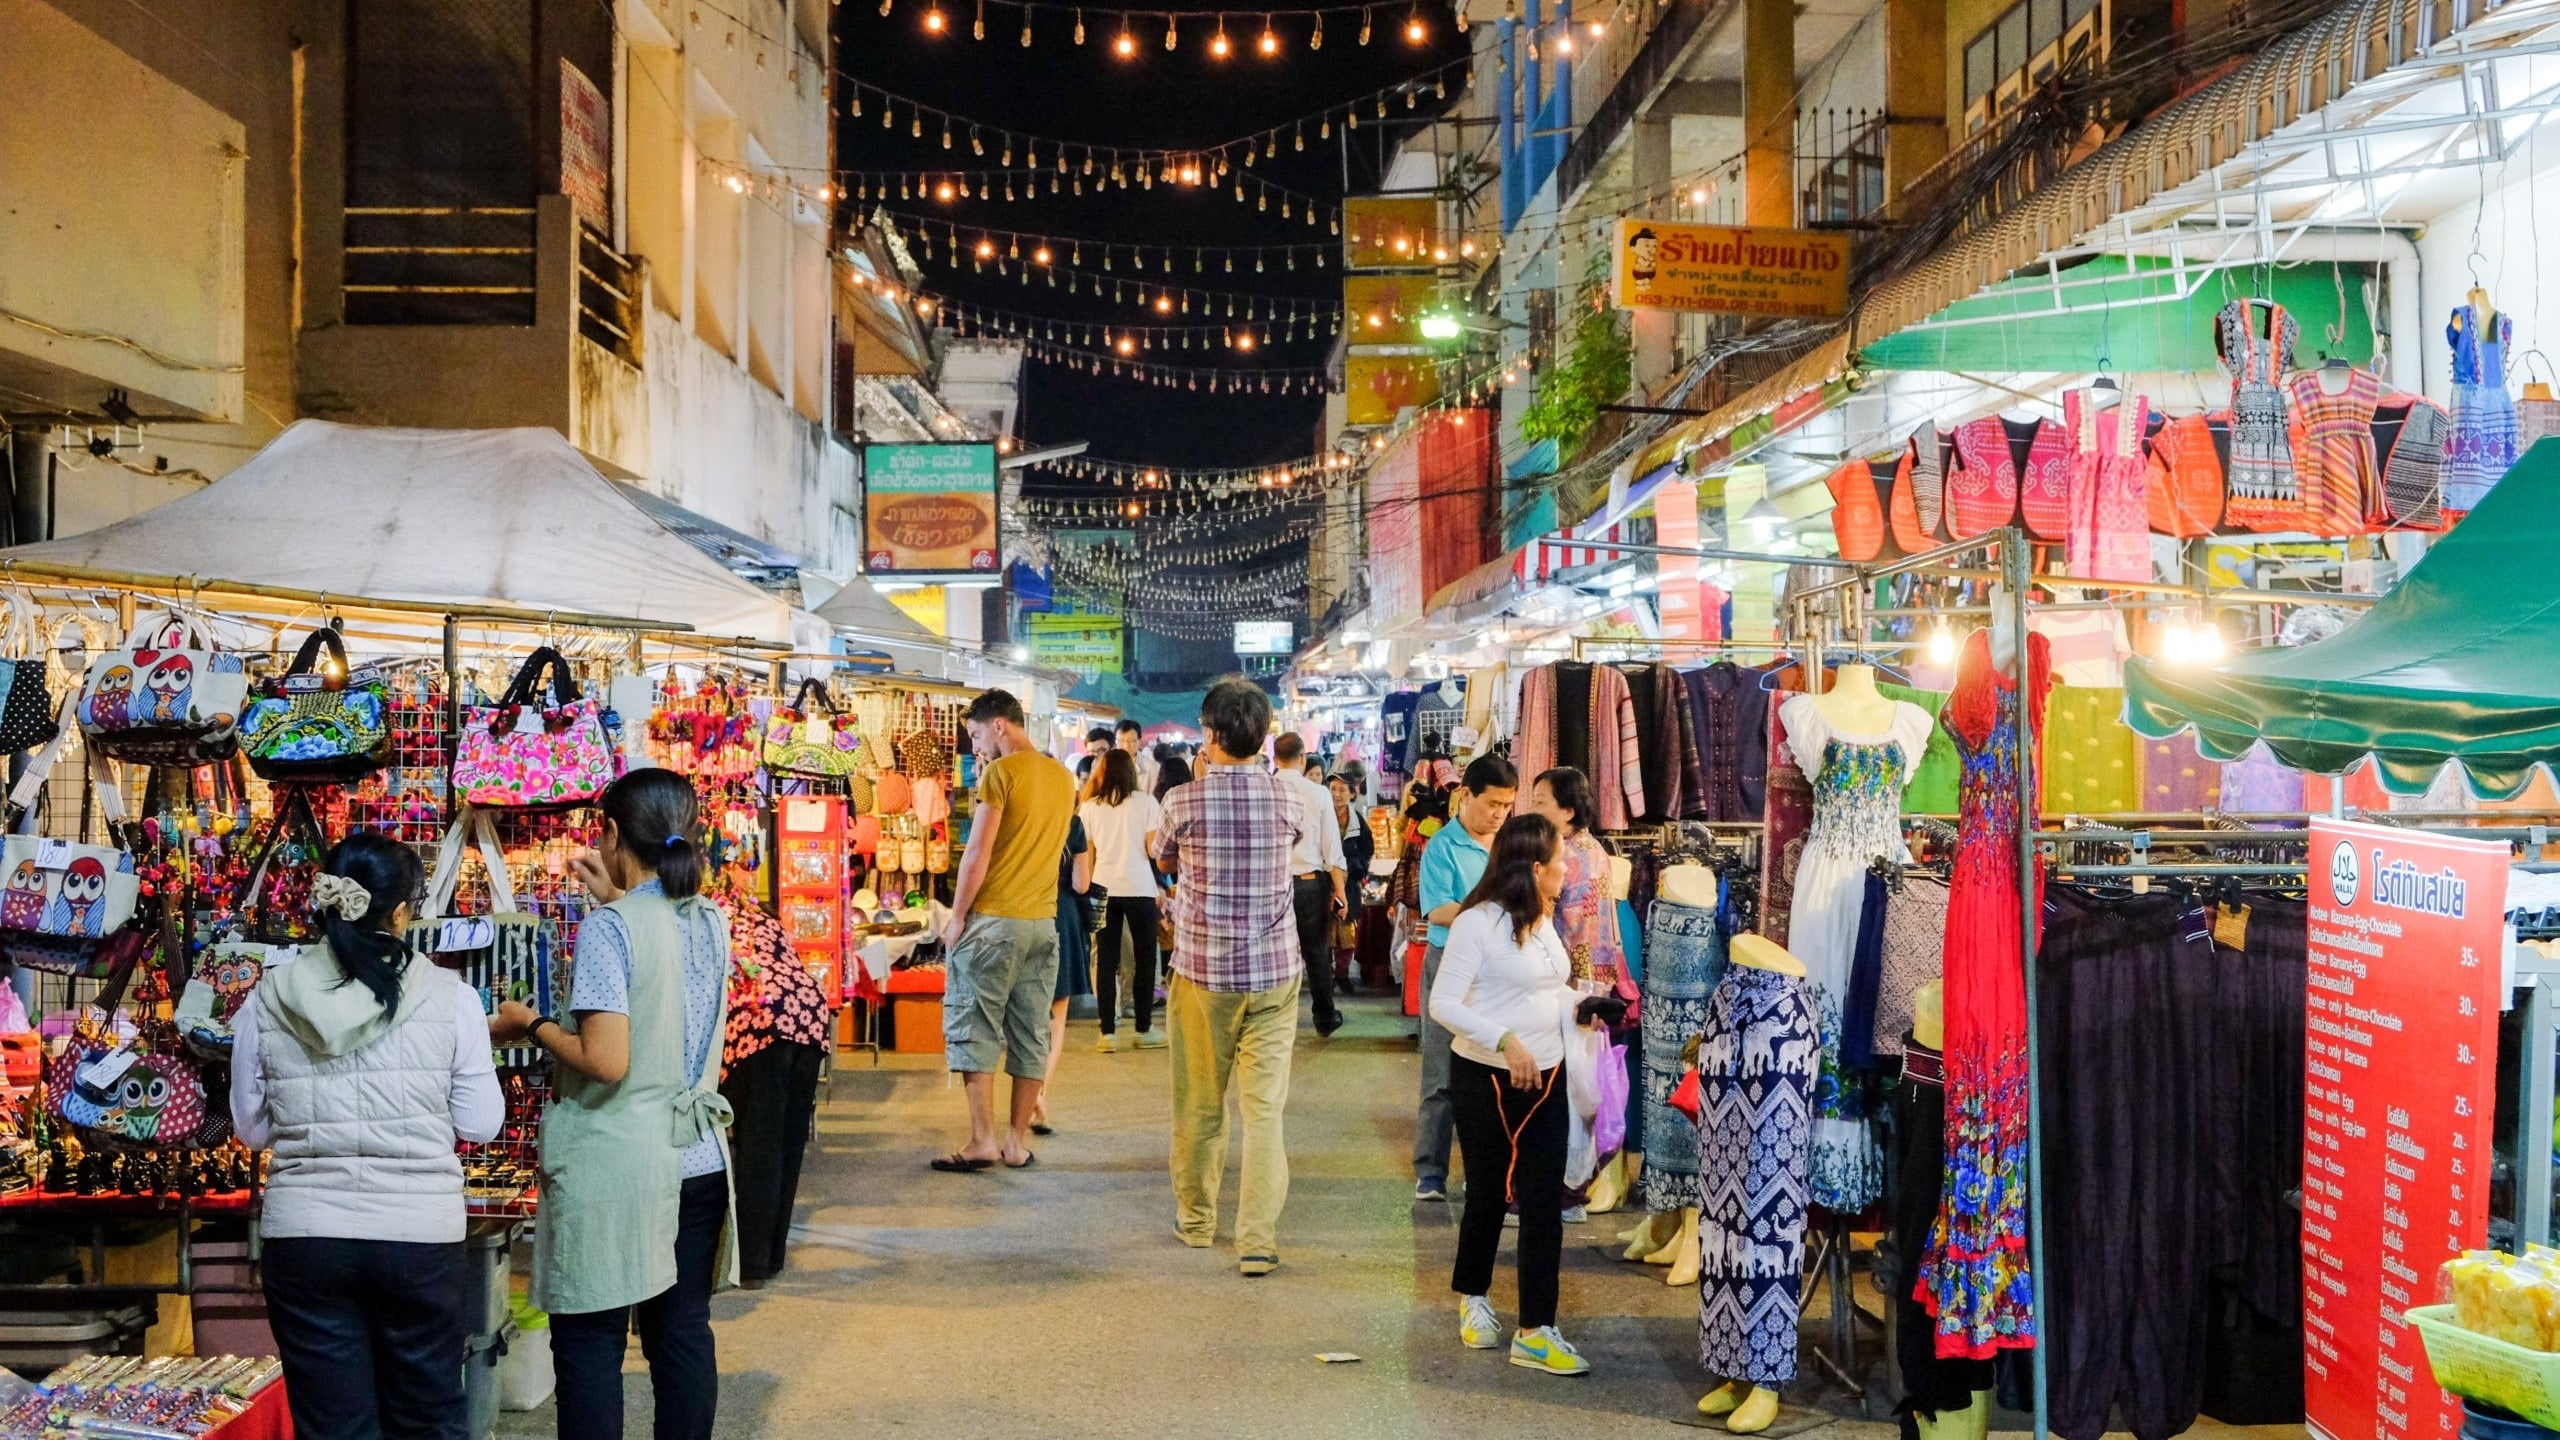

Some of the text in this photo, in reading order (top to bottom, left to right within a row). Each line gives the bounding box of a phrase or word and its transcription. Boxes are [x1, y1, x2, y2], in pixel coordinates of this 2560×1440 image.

[2333, 855, 2357, 882] حلال
[2335, 883, 2353, 895] HALAL
[2372, 850, 2465, 917] โรตีทันสมัย
[2310, 905, 2328, 921] Rotee
[2308, 949, 2366, 978] Rotee Banana-Egg
[2461, 946, 2479, 967] 35.-
[2308, 993, 2326, 1010] Rotee
[2329, 999, 2342, 1017] only
[2458, 996, 2477, 1016] 30.-
[2308, 1036, 2368, 1068] Rotee only Banana
[2457, 1044, 2475, 1064] 30.-
[2307, 1082, 2354, 1113] Rotee with Egg
[2454, 1095, 2472, 1117] 25.-
[2307, 1104, 2323, 1121] Rotee
[2326, 1112, 2339, 1128] with
[2307, 1127, 2339, 1151] Rotee Plain
[2453, 1132, 2467, 1150] 20.-
[2306, 1150, 2345, 1178] Rotee Cheese
[2451, 1158, 2466, 1175] 25.-
[2306, 1173, 2343, 1200] Honey Rotee
[2451, 1184, 2465, 1201] 10.-
[2305, 1195, 2337, 1221] Rotee Milo
[2448, 1209, 2463, 1227] 20.-
[2304, 1218, 2332, 1242] Chocolate
[2319, 1249, 2343, 1272] Coconut
[2320, 1269, 2347, 1297] Pineapple
[2306, 1286, 2325, 1309] Orange
[2306, 1308, 2335, 1339] Strawberry
[2320, 1339, 2338, 1362] Raisins
[2306, 1353, 2328, 1382] Blueberry
[2377, 1371, 2387, 1393] โรตี
[2439, 1412, 2452, 1431] 15.-
